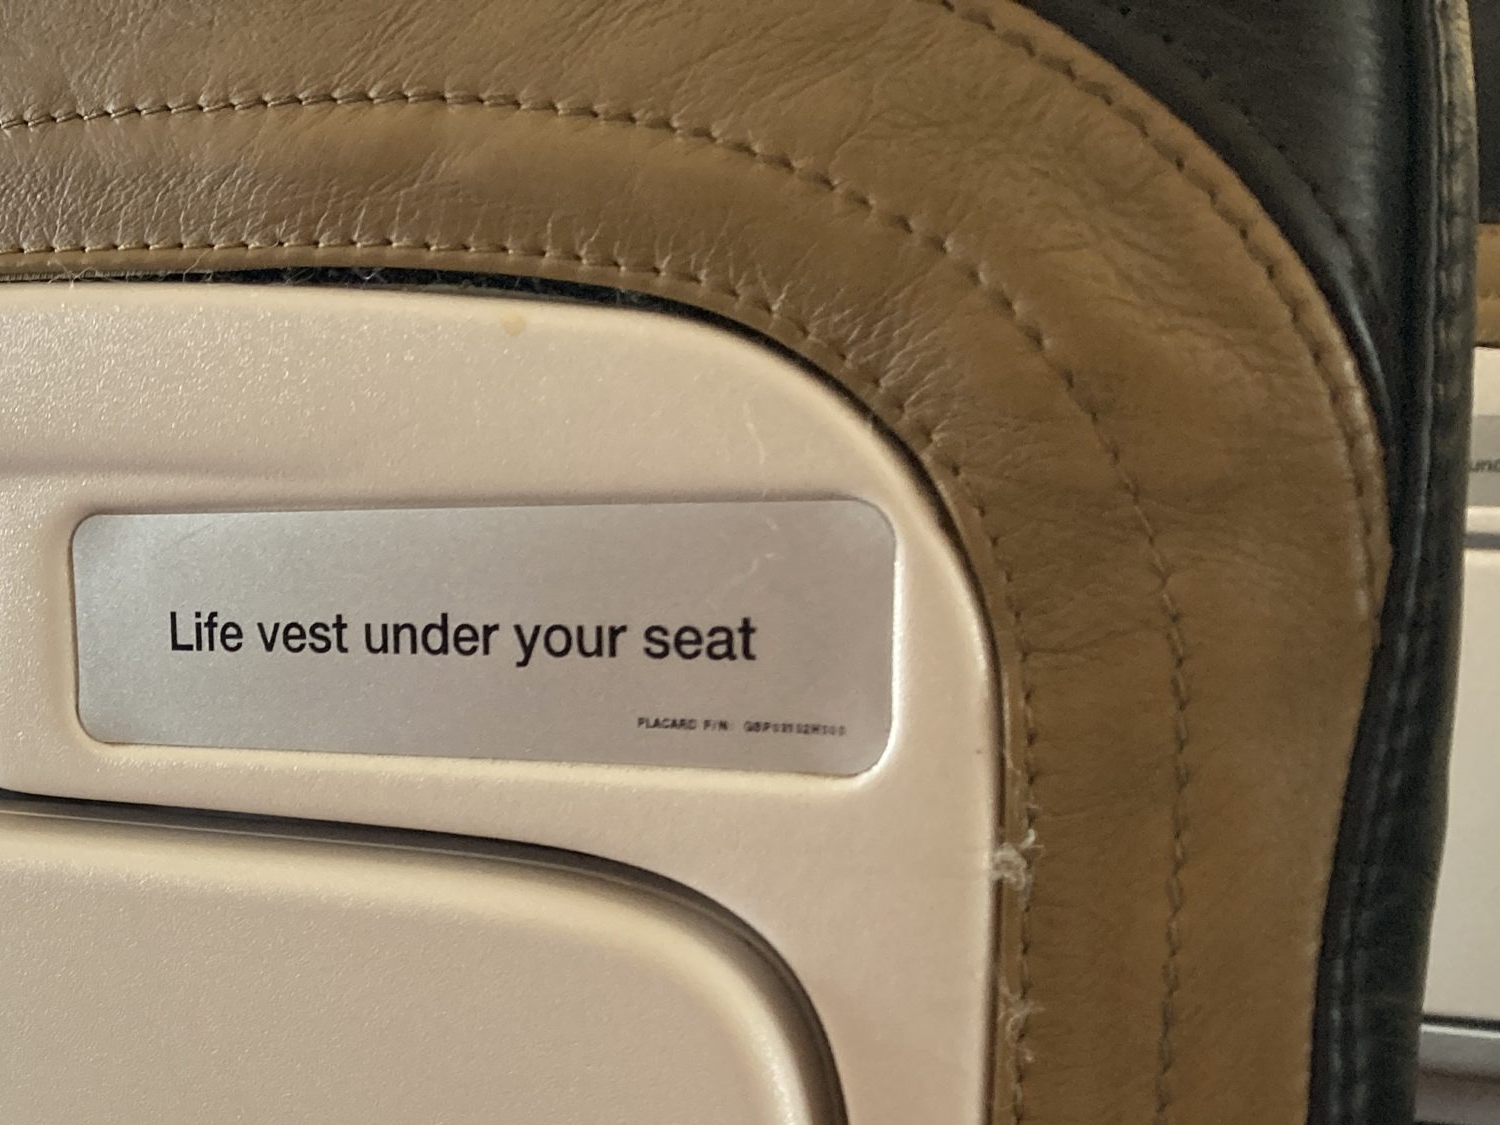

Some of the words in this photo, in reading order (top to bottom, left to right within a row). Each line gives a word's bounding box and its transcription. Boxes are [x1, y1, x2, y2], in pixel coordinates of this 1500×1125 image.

[169, 610, 244, 653] Life
[256, 613, 349, 654] vest
[363, 611, 500, 657] under
[512, 623, 628, 668] your
[642, 616, 758, 662] seat
[636, 716, 698, 731] PLACARD
